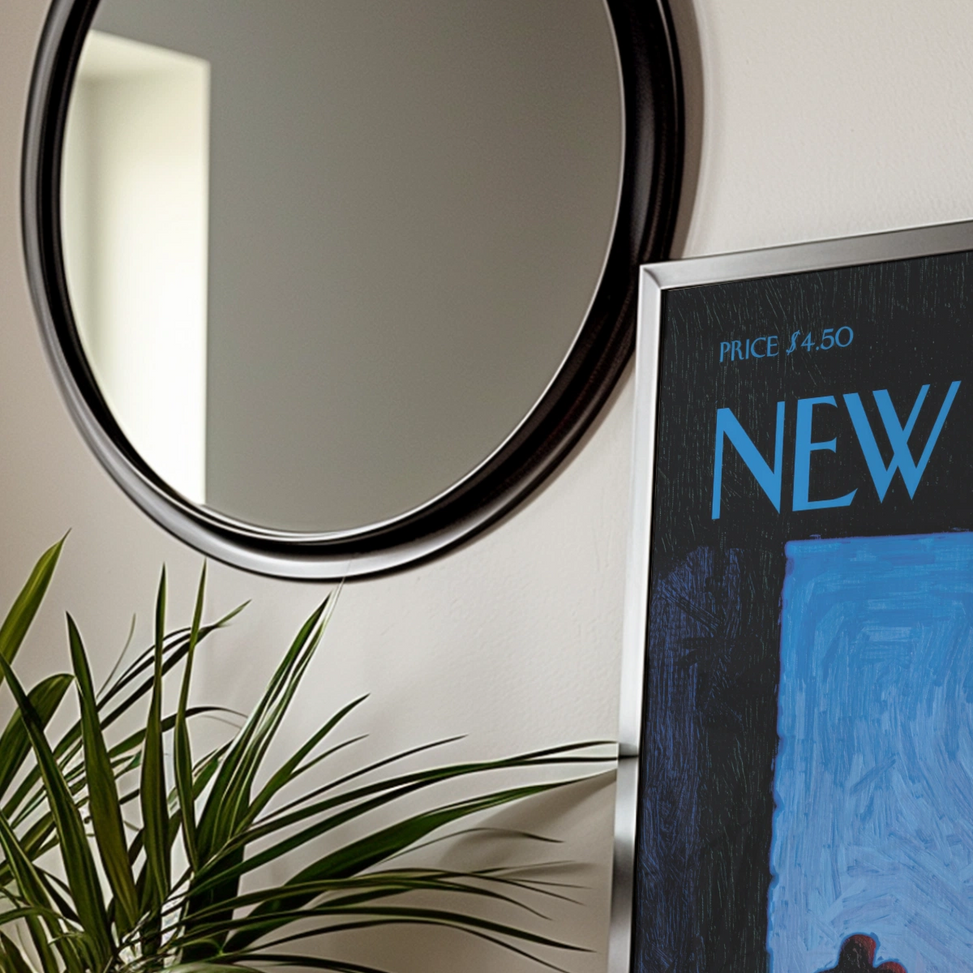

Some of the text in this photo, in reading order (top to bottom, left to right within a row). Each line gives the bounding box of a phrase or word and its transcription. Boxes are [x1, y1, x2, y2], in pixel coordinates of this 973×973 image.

[719, 325, 854, 363] PRICE $4.50
[710, 380, 962, 521] NEW
